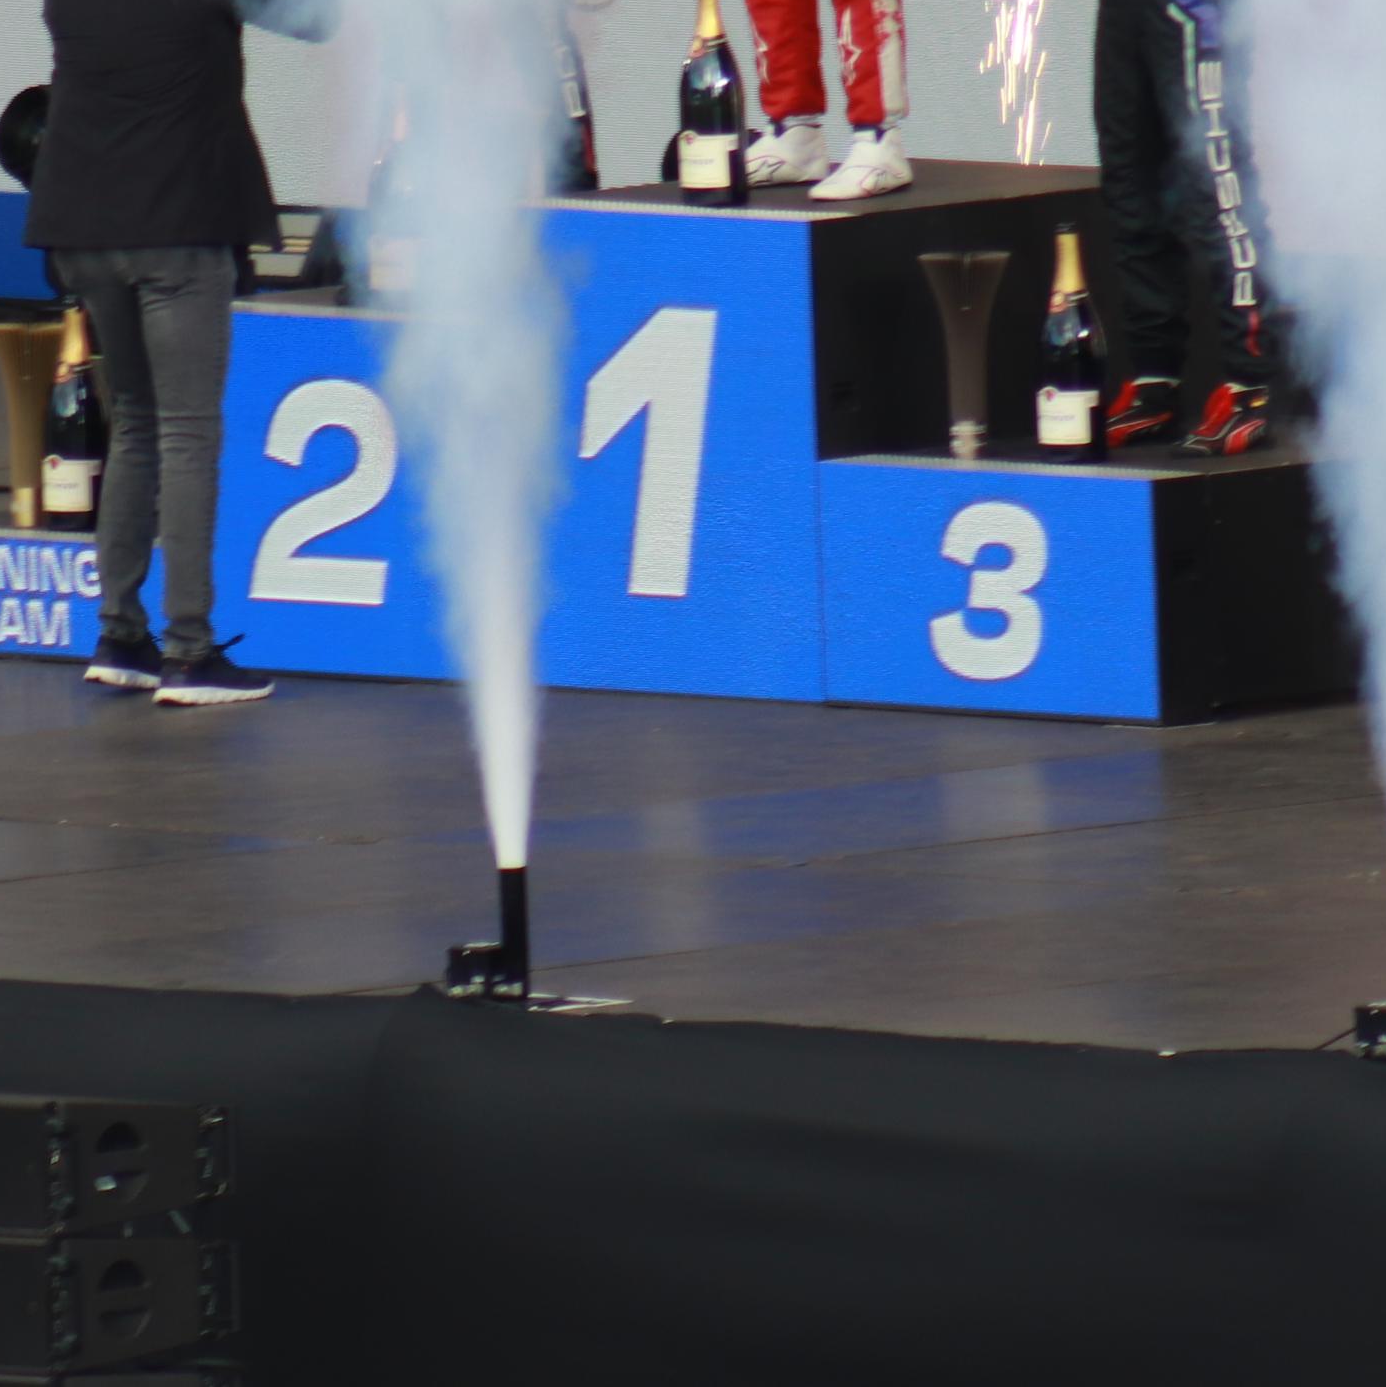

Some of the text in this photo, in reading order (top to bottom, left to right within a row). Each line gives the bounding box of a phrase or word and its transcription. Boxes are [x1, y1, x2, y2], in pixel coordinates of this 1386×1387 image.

[249, 378, 399, 606] 2
[578, 307, 718, 598] 1
[929, 501, 1049, 681] 3
